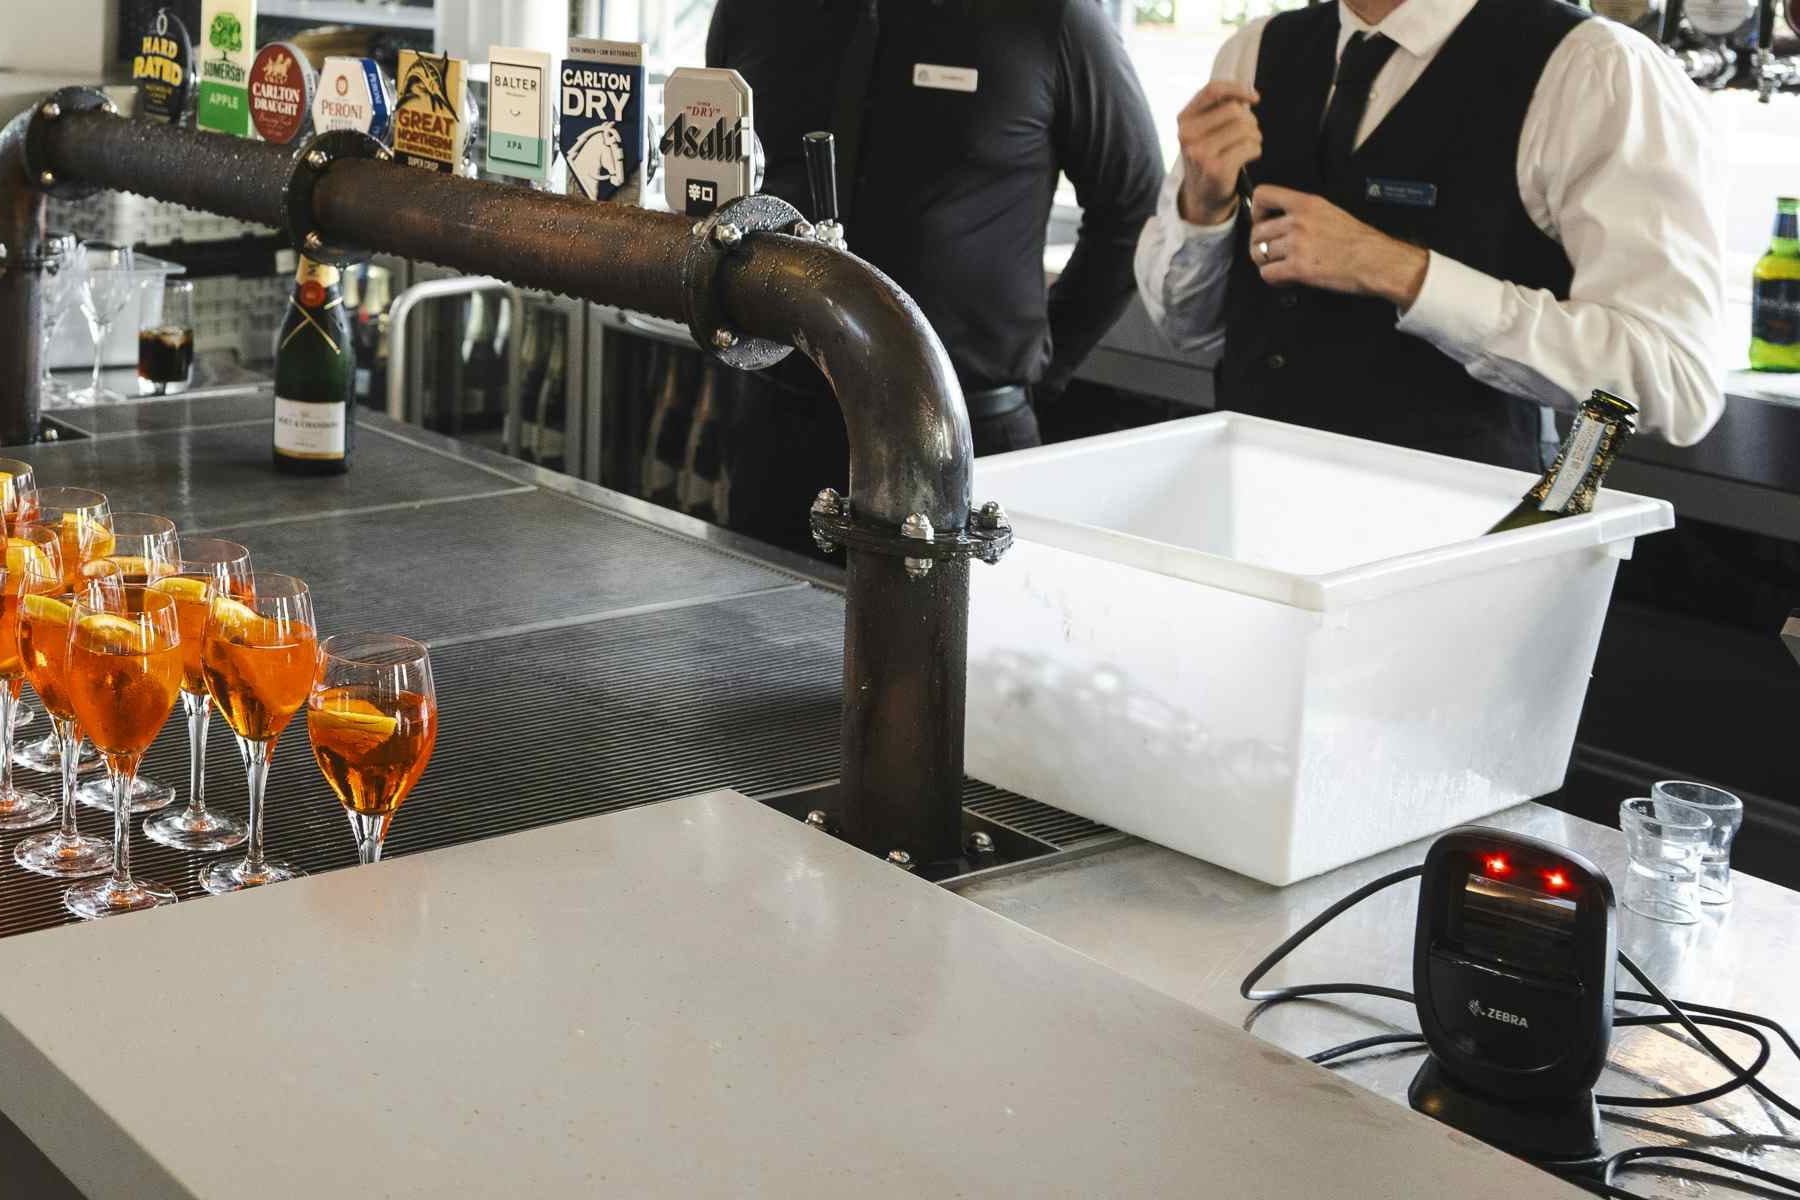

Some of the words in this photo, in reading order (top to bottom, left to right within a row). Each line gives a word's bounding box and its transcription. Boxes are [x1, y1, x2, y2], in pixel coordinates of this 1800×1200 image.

[142, 36, 178, 59] HARD
[133, 55, 183, 87] RATED
[203, 60, 246, 82] SOMERSBY
[562, 68, 631, 92] CARLTON
[252, 81, 301, 103] CARLTON
[494, 75, 537, 92] BALTER
[208, 92, 239, 110] APPLE
[254, 97, 299, 116] DRAUGHT
[321, 100, 364, 120] PERONI
[562, 86, 631, 122] DRY
[398, 108, 455, 137] GREAT
[397, 127, 453, 150] NORTHERN
[506, 140, 523, 150] XPA
[659, 112, 743, 163] Asahi
[408, 157, 424, 168] SUPER
[1487, 1006, 1529, 1029] ZEBRA
